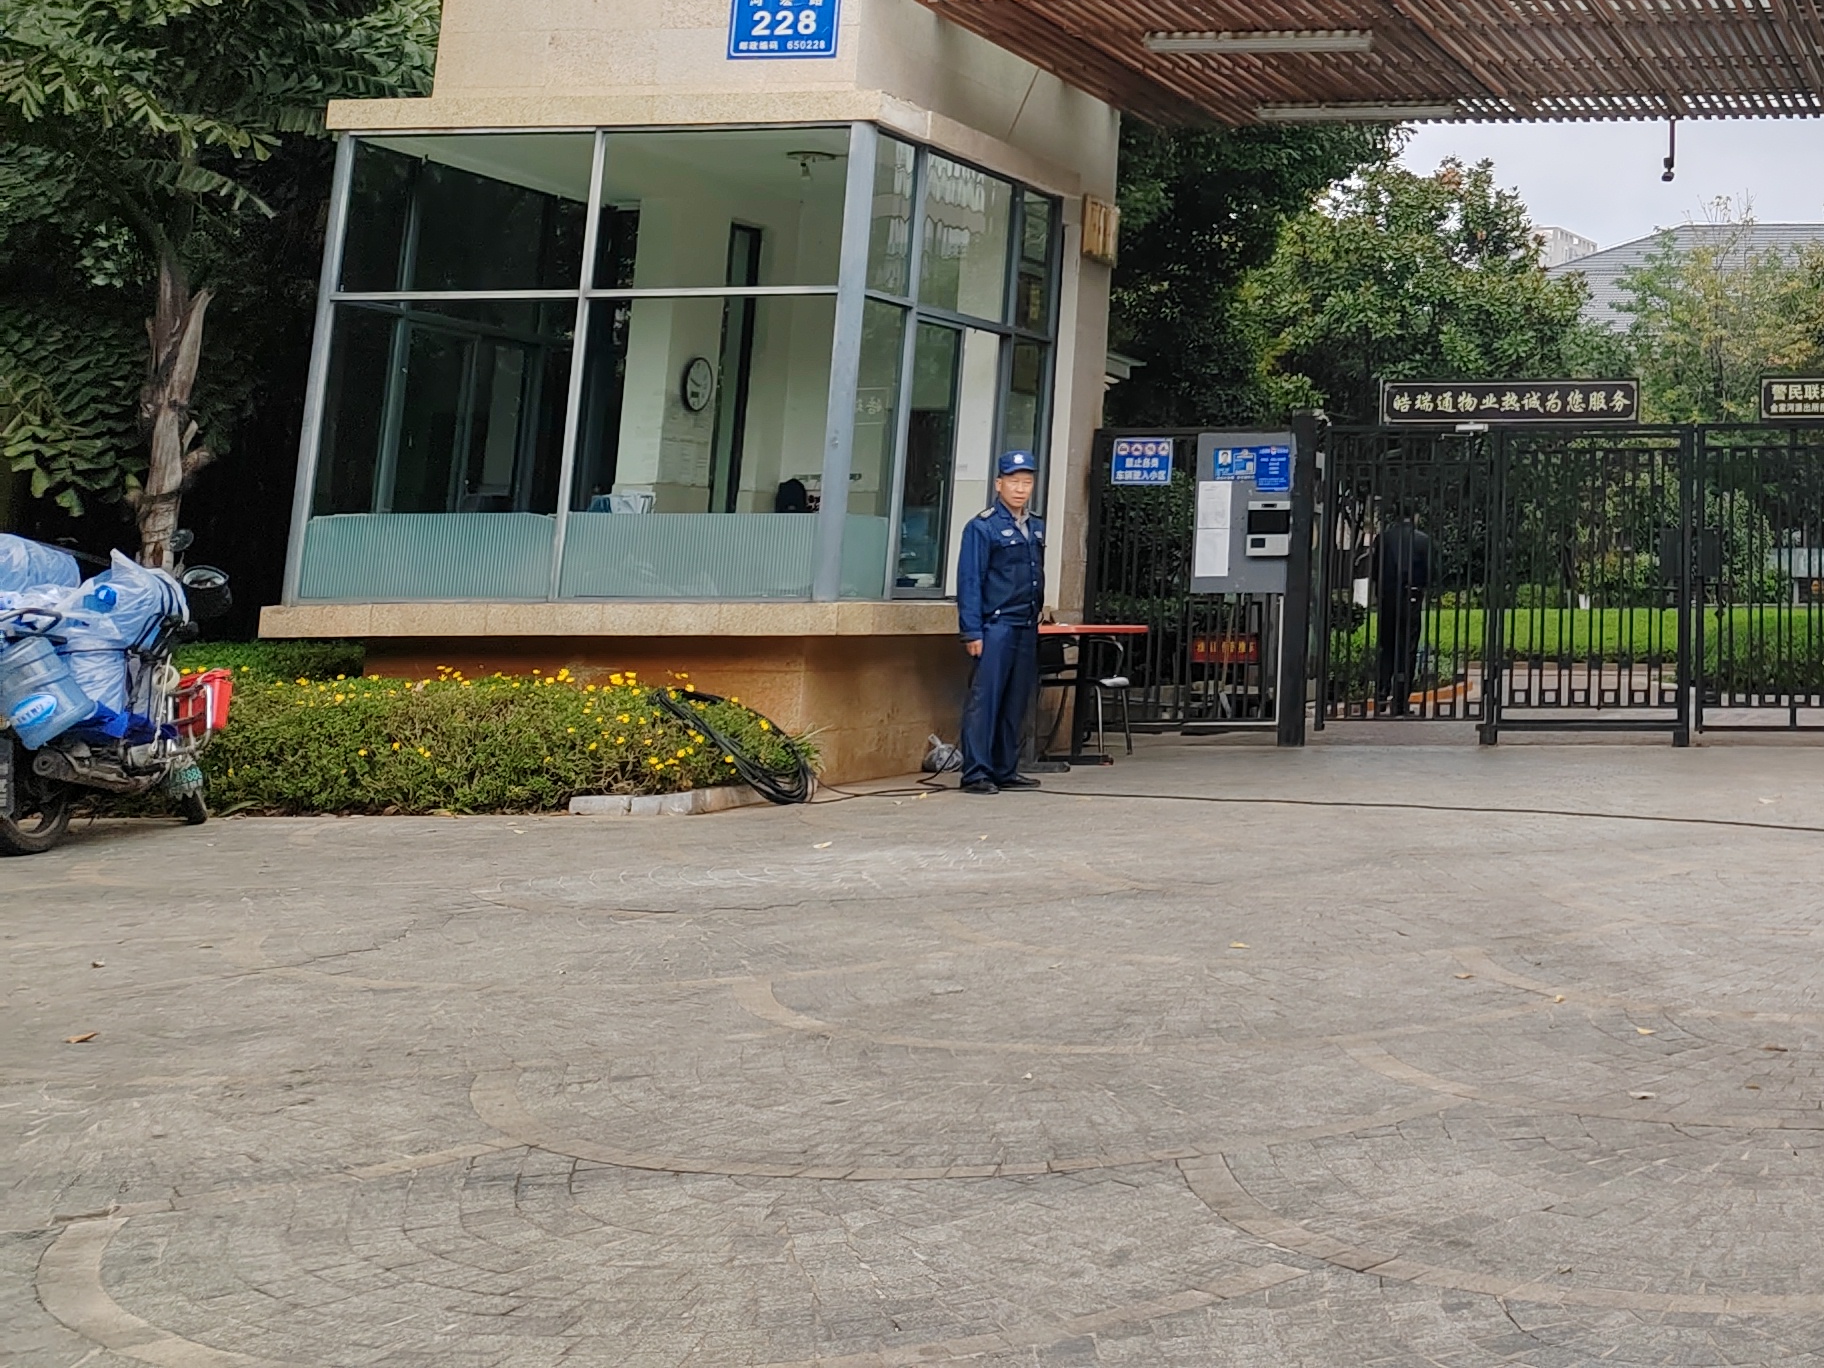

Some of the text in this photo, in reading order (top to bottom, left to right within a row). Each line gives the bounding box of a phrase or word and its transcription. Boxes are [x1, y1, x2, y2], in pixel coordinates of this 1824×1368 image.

[751, 9, 816, 36] 228
[787, 40, 825, 49] 650228
[1393, 389, 1631, 413] 皓瑞通物业热诚为您服务
